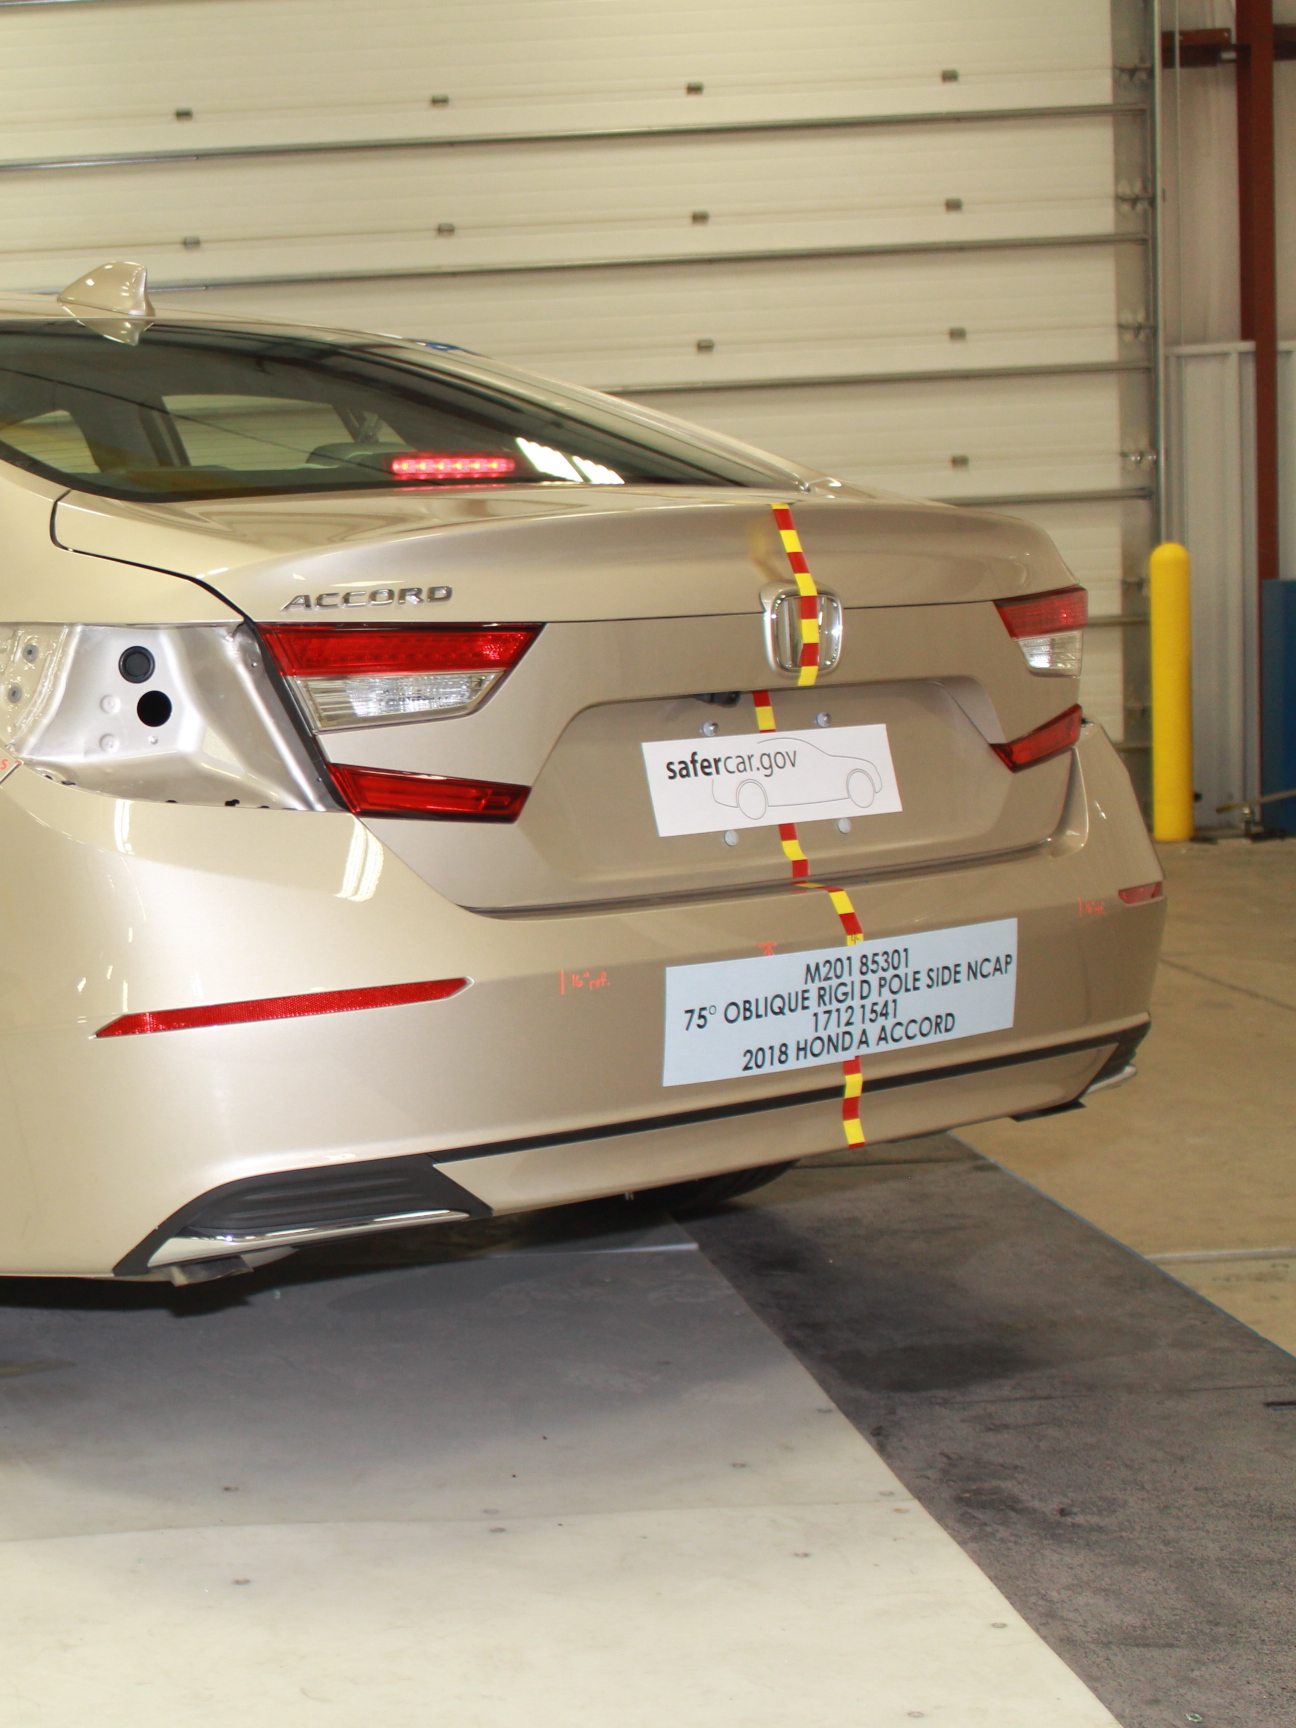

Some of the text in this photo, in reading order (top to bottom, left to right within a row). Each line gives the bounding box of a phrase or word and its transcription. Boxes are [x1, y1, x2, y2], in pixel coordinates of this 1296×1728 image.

[279, 585, 453, 613] ACCORD
[665, 749, 798, 780] safercar.gov
[684, 1004, 717, 1031] 75°
[723, 989, 810, 1024] OBLIQUE
[878, 970, 922, 998] POLE
[926, 963, 962, 990] SIDE
[966, 953, 1014, 982] NCAP
[741, 1042, 790, 1072] 2018
[875, 1012, 956, 1048] ACCORD
